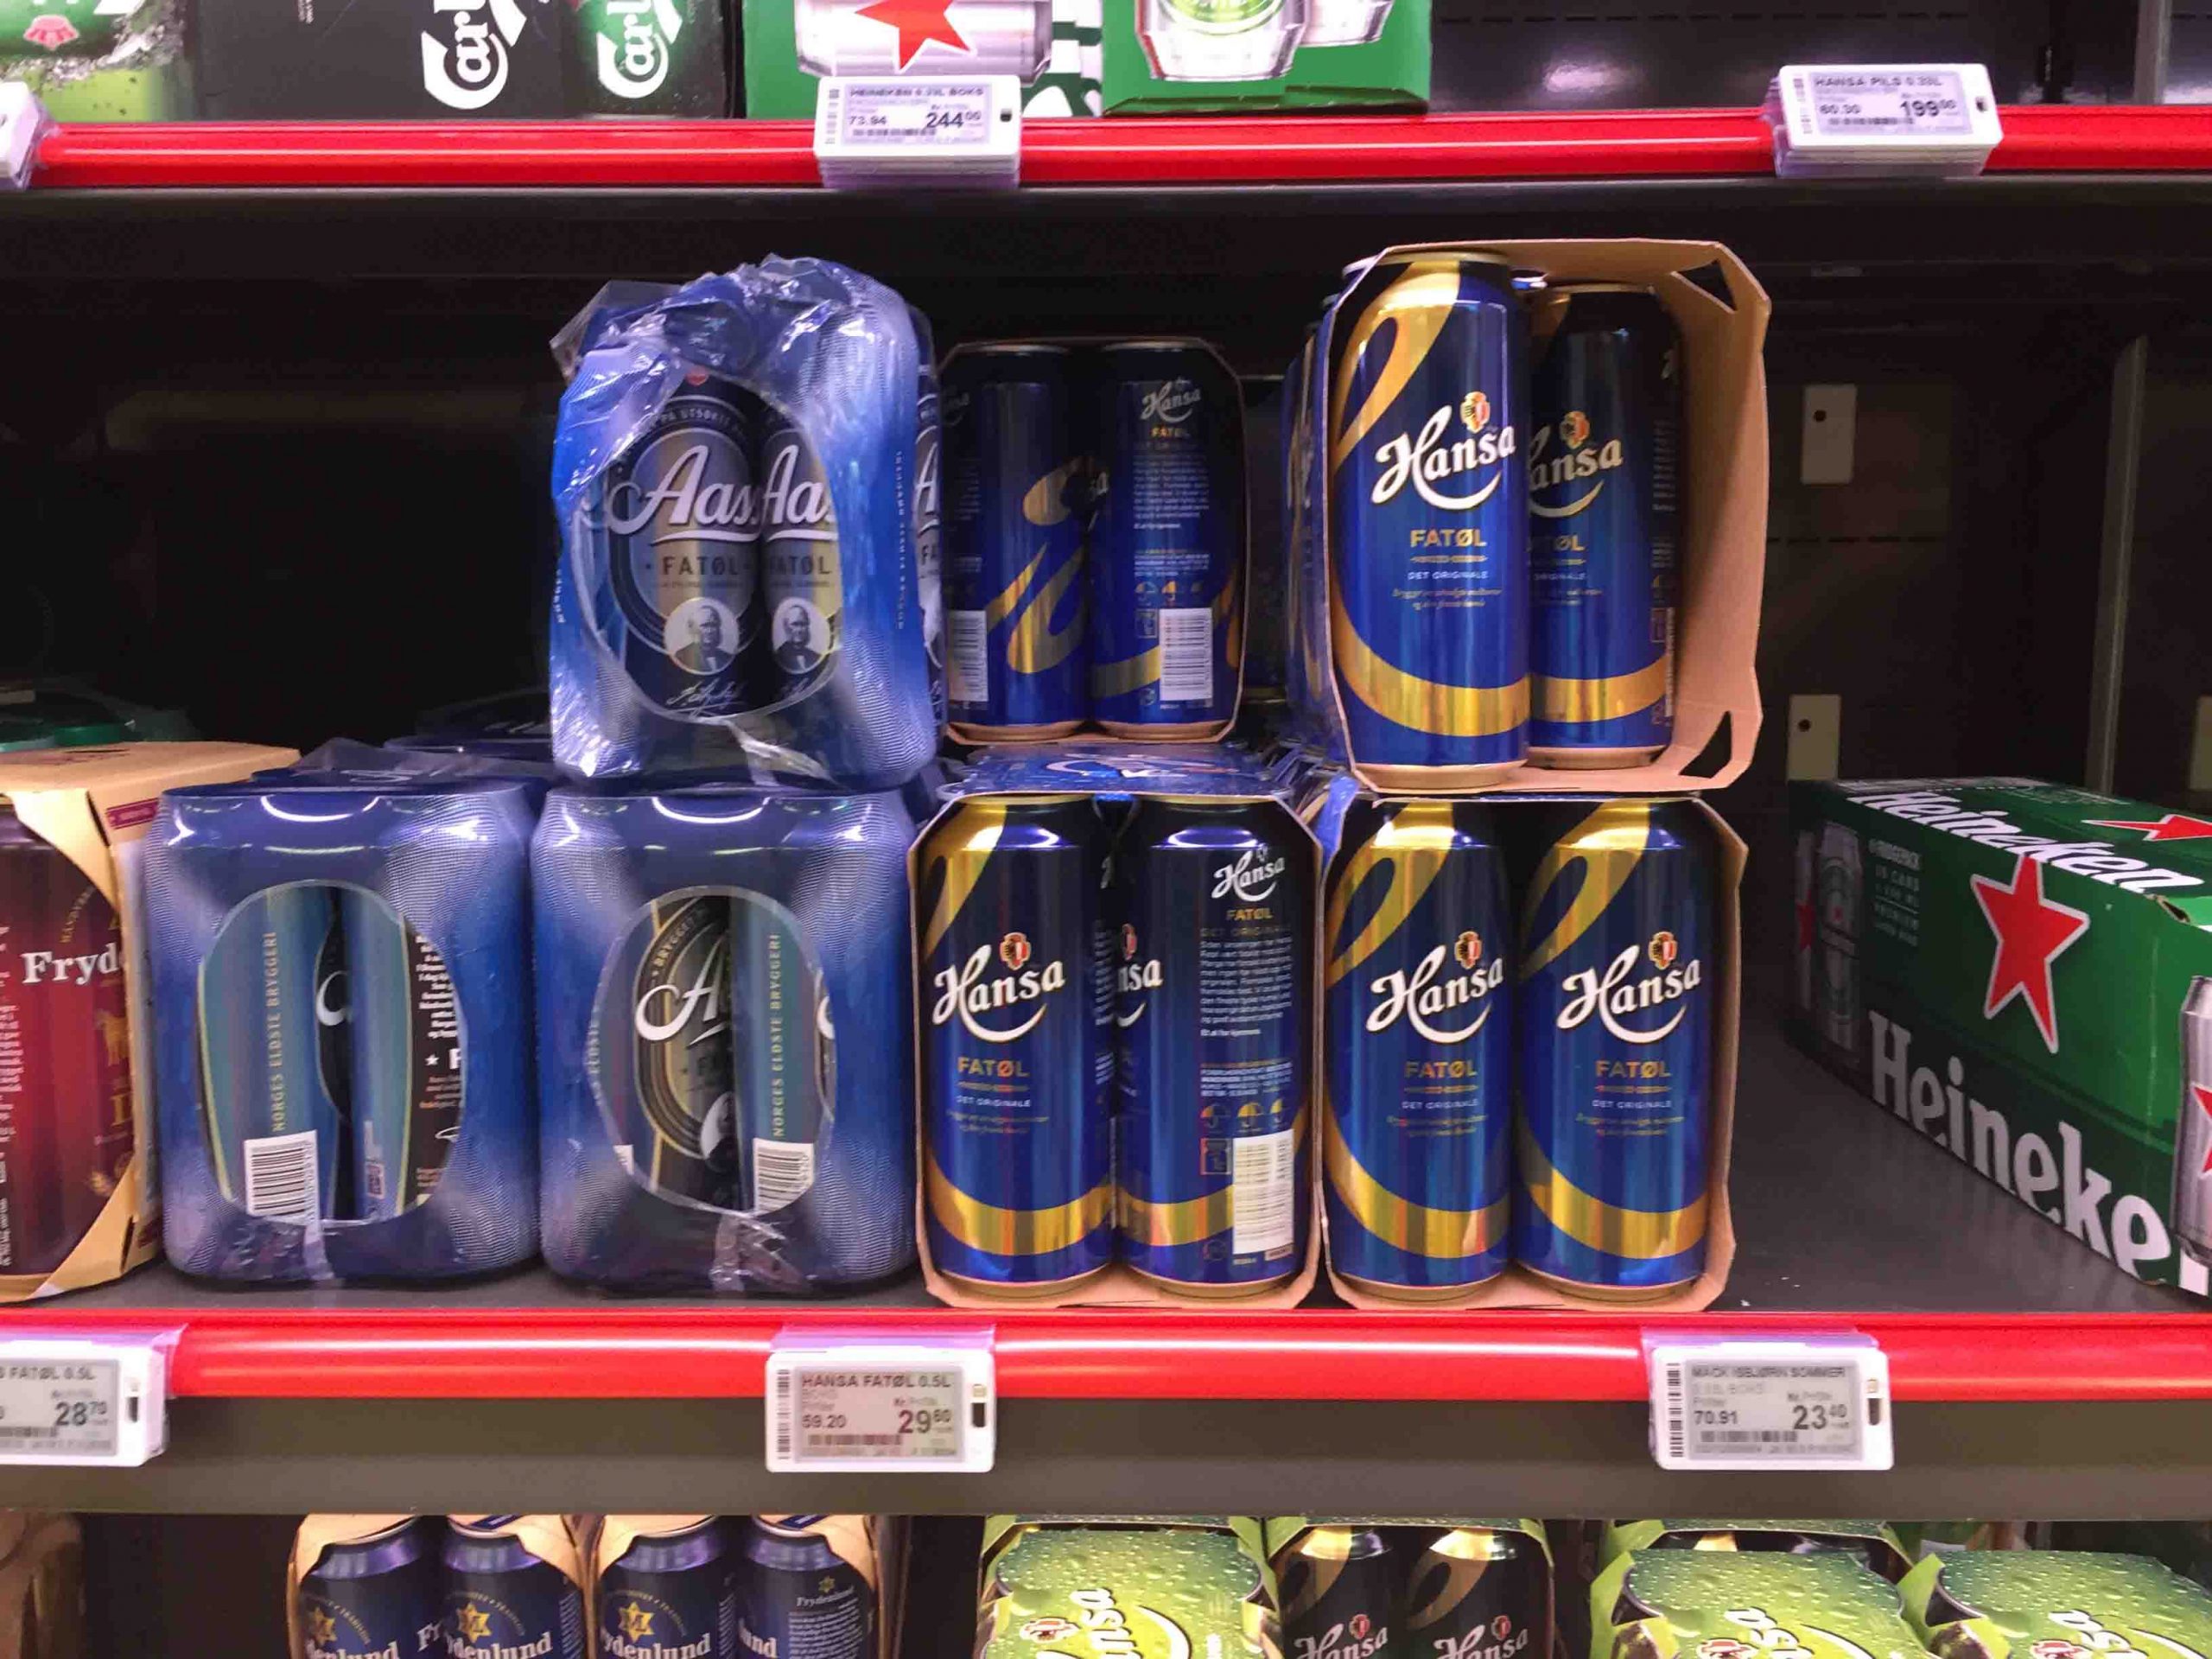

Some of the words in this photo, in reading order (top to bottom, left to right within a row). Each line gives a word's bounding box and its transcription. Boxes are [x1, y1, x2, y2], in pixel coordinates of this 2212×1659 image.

[924, 111, 964, 129] 244
[1899, 99, 1939, 118] 199
[1141, 380, 1202, 423] Hansa
[1370, 404, 1517, 510] Hansa
[610, 444, 757, 536] Aas
[1409, 529, 1488, 549] FATØL
[662, 556, 739, 576] FATØL
[1844, 791, 2204, 895] Heineken
[1211, 850, 1286, 902] Hansa
[932, 944, 1066, 1043] Hansa
[1365, 944, 1505, 1044] Hansa
[1556, 944, 1701, 1044] Hansa
[957, 1057, 1031, 1078] FATØL
[1404, 1059, 1479, 1079] FATØL
[1595, 1059, 1673, 1079] FATØL
[800, 1375, 859, 1388] HANSA
[863, 1375, 916, 1388] FATØL
[918, 1375, 951, 1388] 0.5L
[54, 1401, 87, 1427] 28
[801, 1414, 847, 1429] 59.20
[897, 1408, 932, 1434] 29
[1694, 1409, 1738, 1425] 70.91
[1792, 1405, 1827, 1431] 23
